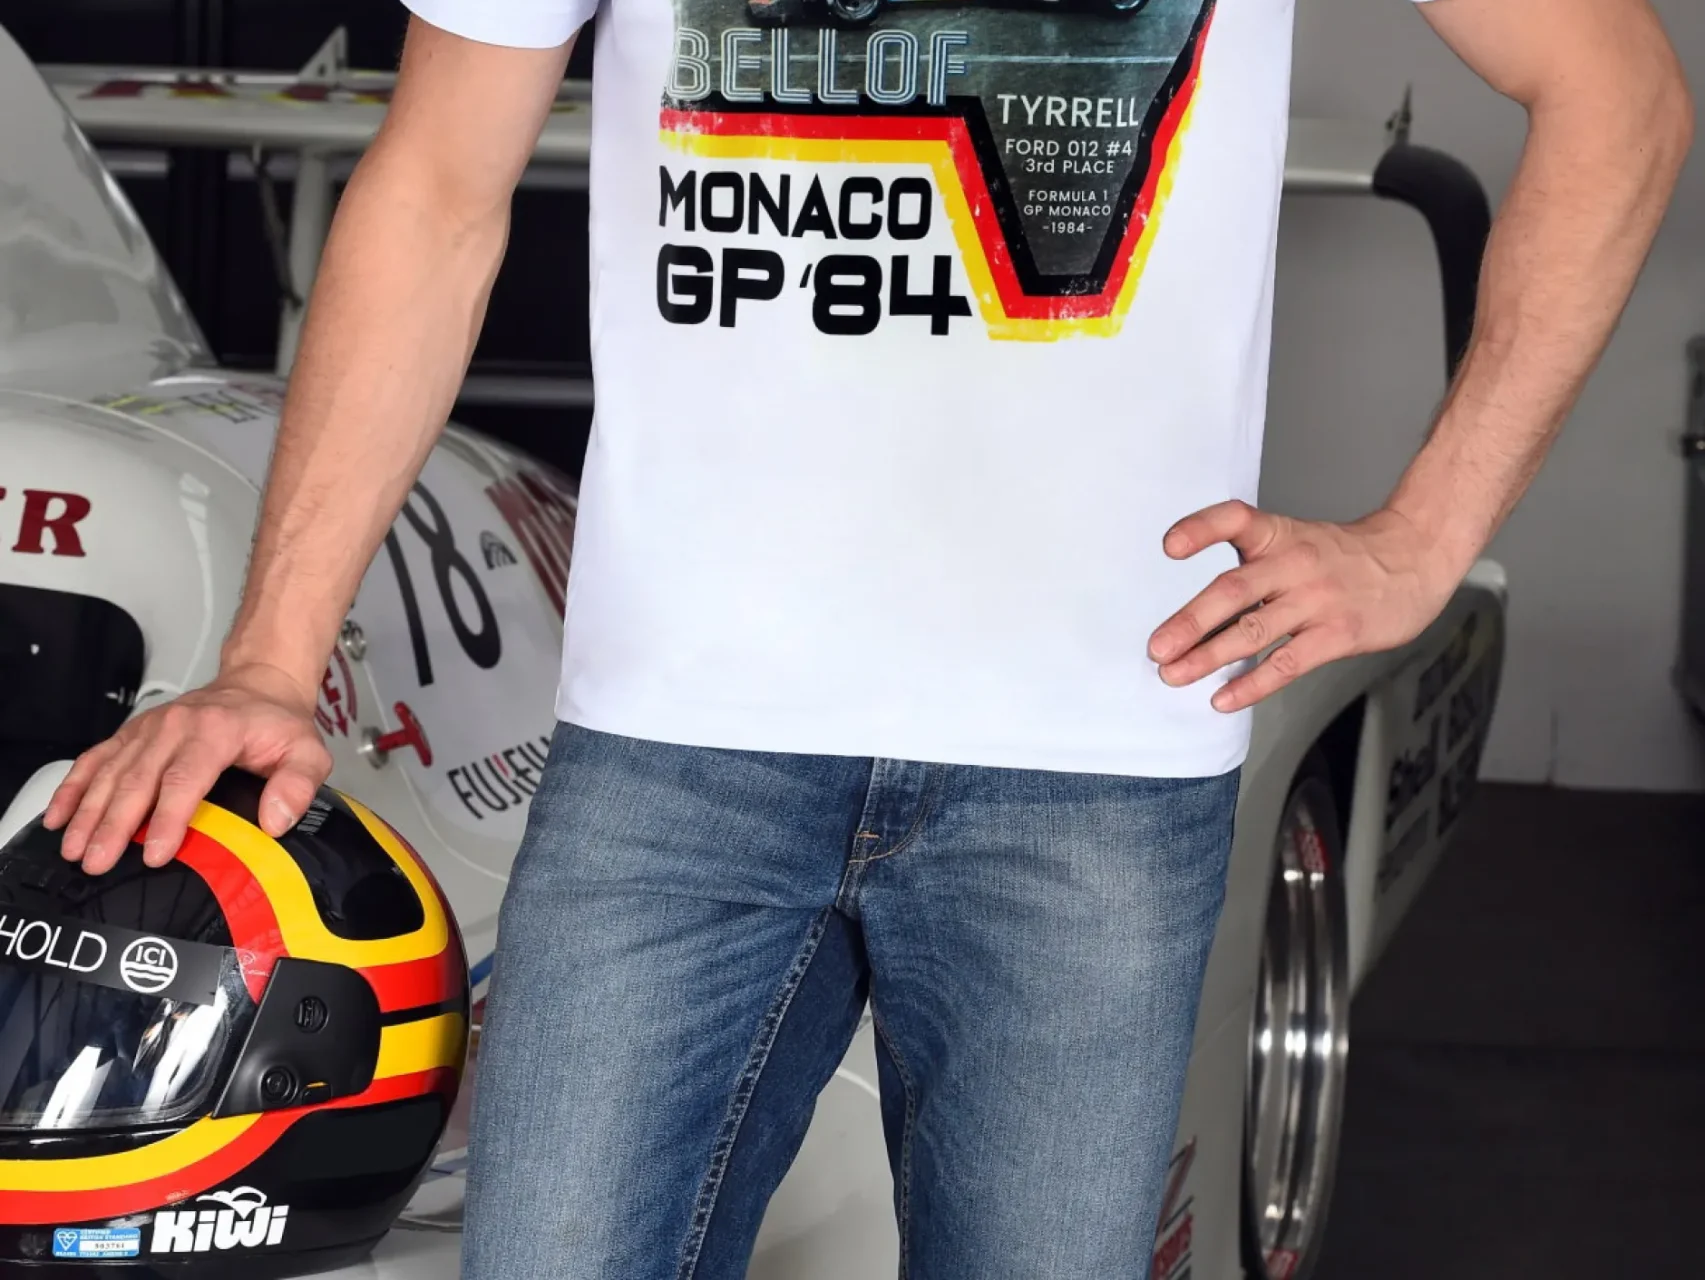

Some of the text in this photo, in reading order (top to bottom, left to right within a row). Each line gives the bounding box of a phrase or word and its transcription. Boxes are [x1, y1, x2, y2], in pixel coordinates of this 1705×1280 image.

[667, 27, 969, 106] BELLOF
[997, 94, 1139, 127] TYRRELL
[1005, 138, 1132, 157] FORD 012 #4
[1025, 158, 1114, 174] 3rd PLACE
[658, 165, 932, 240] MONACO
[1023, 205, 1111, 216] GP MONACO
[1028, 190, 1108, 202] FORMULA 1
[656, 243, 785, 327] GP
[0, 485, 92, 557] R
[0, 914, 108, 973] HOLD
[135, 945, 167, 967] ICI
